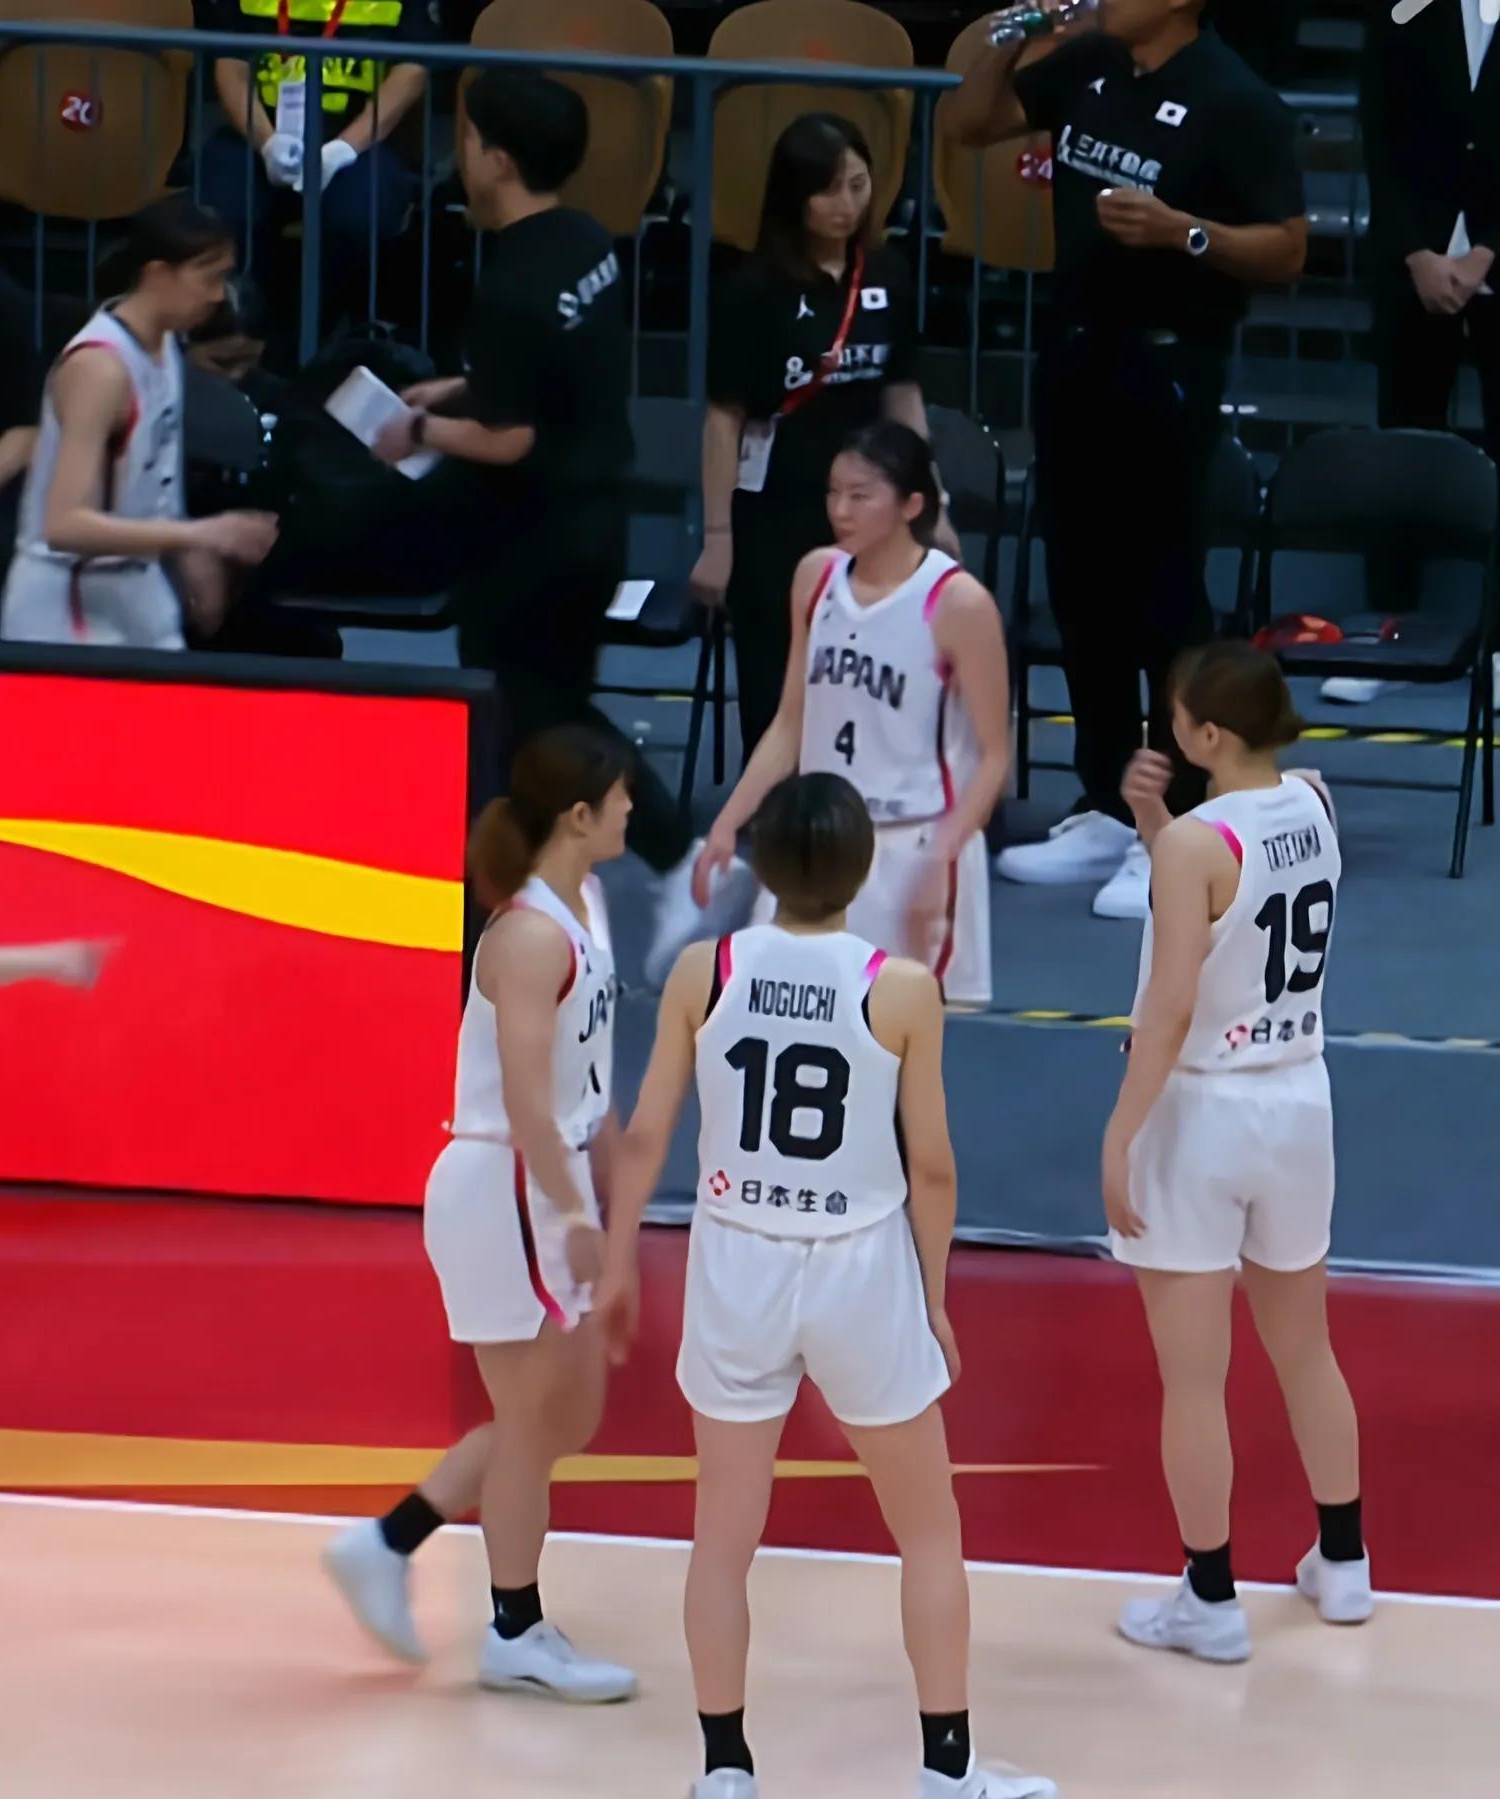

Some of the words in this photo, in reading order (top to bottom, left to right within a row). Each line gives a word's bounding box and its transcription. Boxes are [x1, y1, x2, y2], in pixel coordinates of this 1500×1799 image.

[834, 719, 855, 766] 4
[1254, 878, 1334, 1004] 19
[748, 977, 837, 1023] NOGUCHI
[724, 1036, 851, 1161] 18
[741, 1179, 849, 1216] 日本生命
